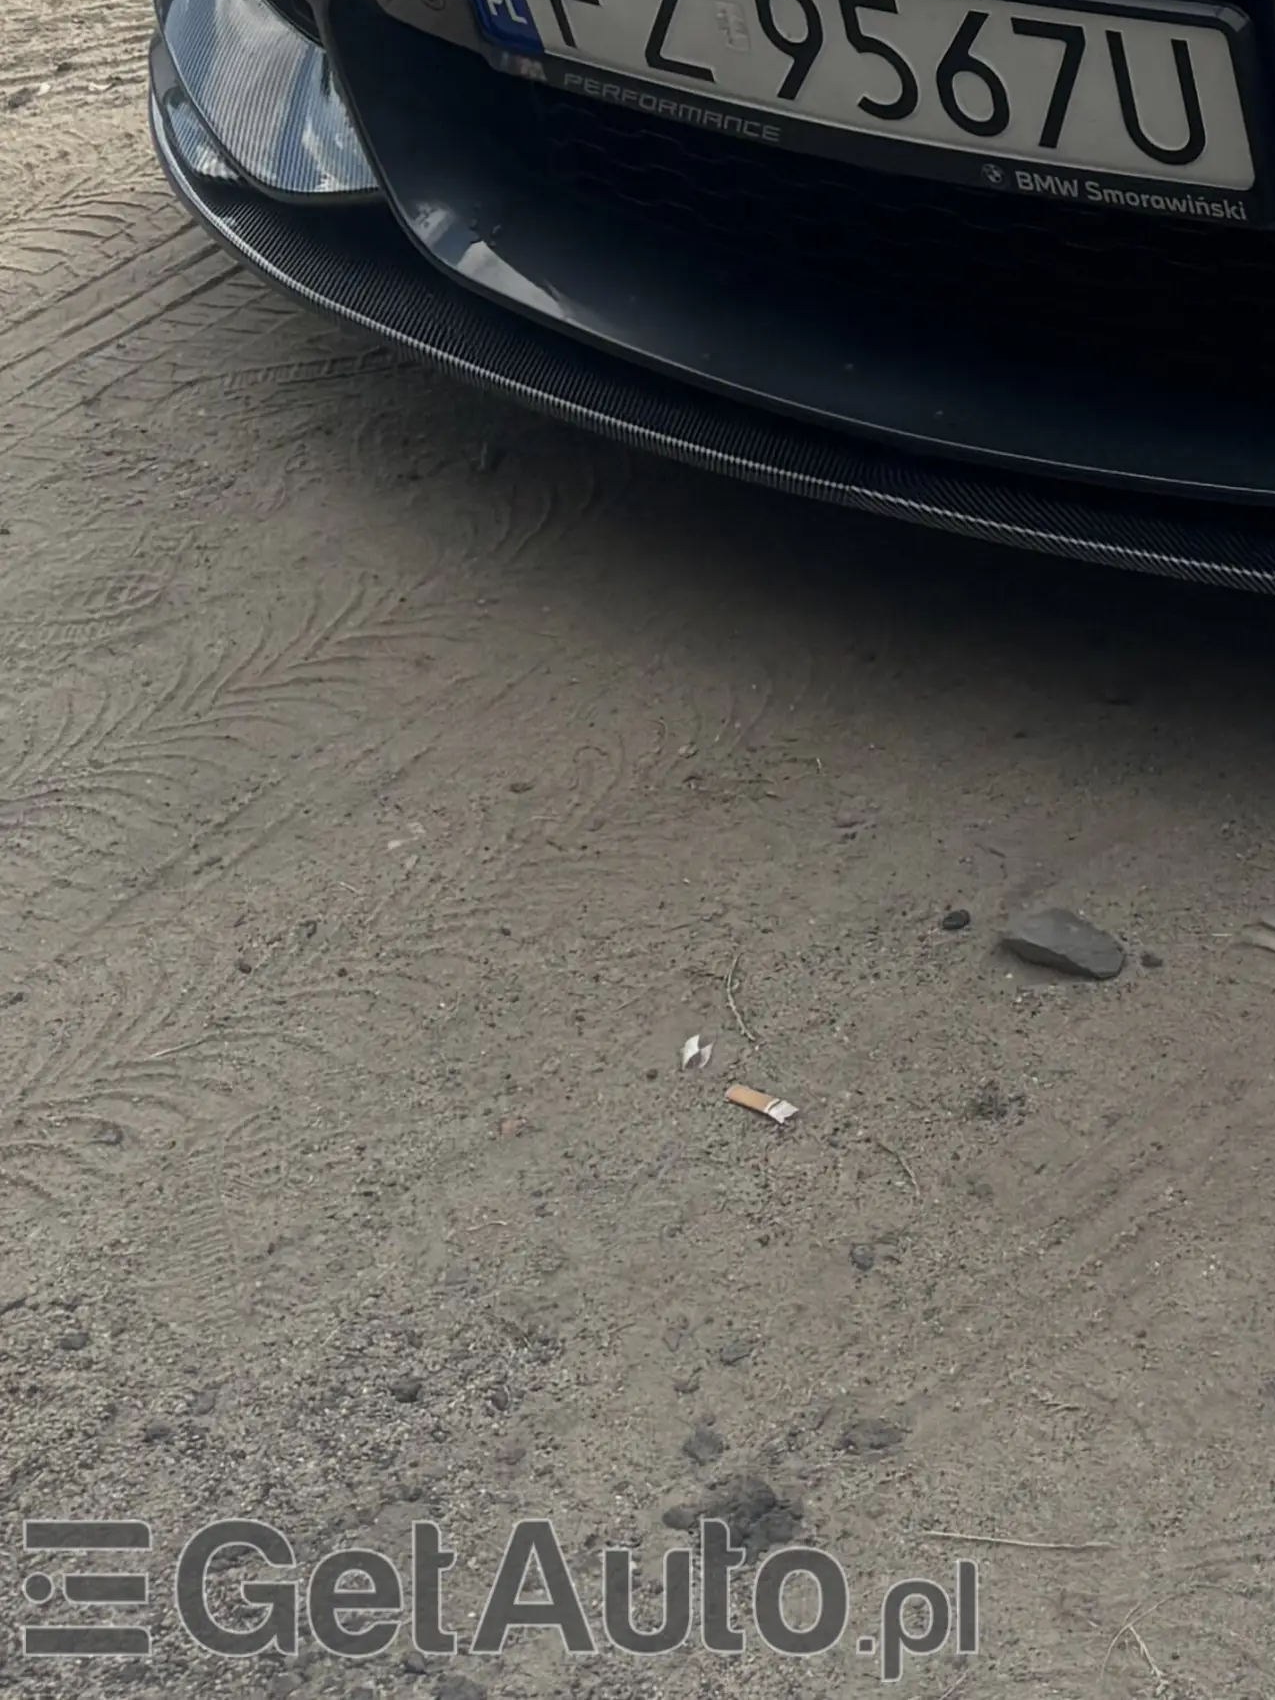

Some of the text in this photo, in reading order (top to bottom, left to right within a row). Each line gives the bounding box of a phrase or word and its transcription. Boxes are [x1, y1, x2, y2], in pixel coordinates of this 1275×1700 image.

[564, 73, 782, 143] PERFORMANCE
[1015, 170, 1249, 221] BMW Smorawiński
